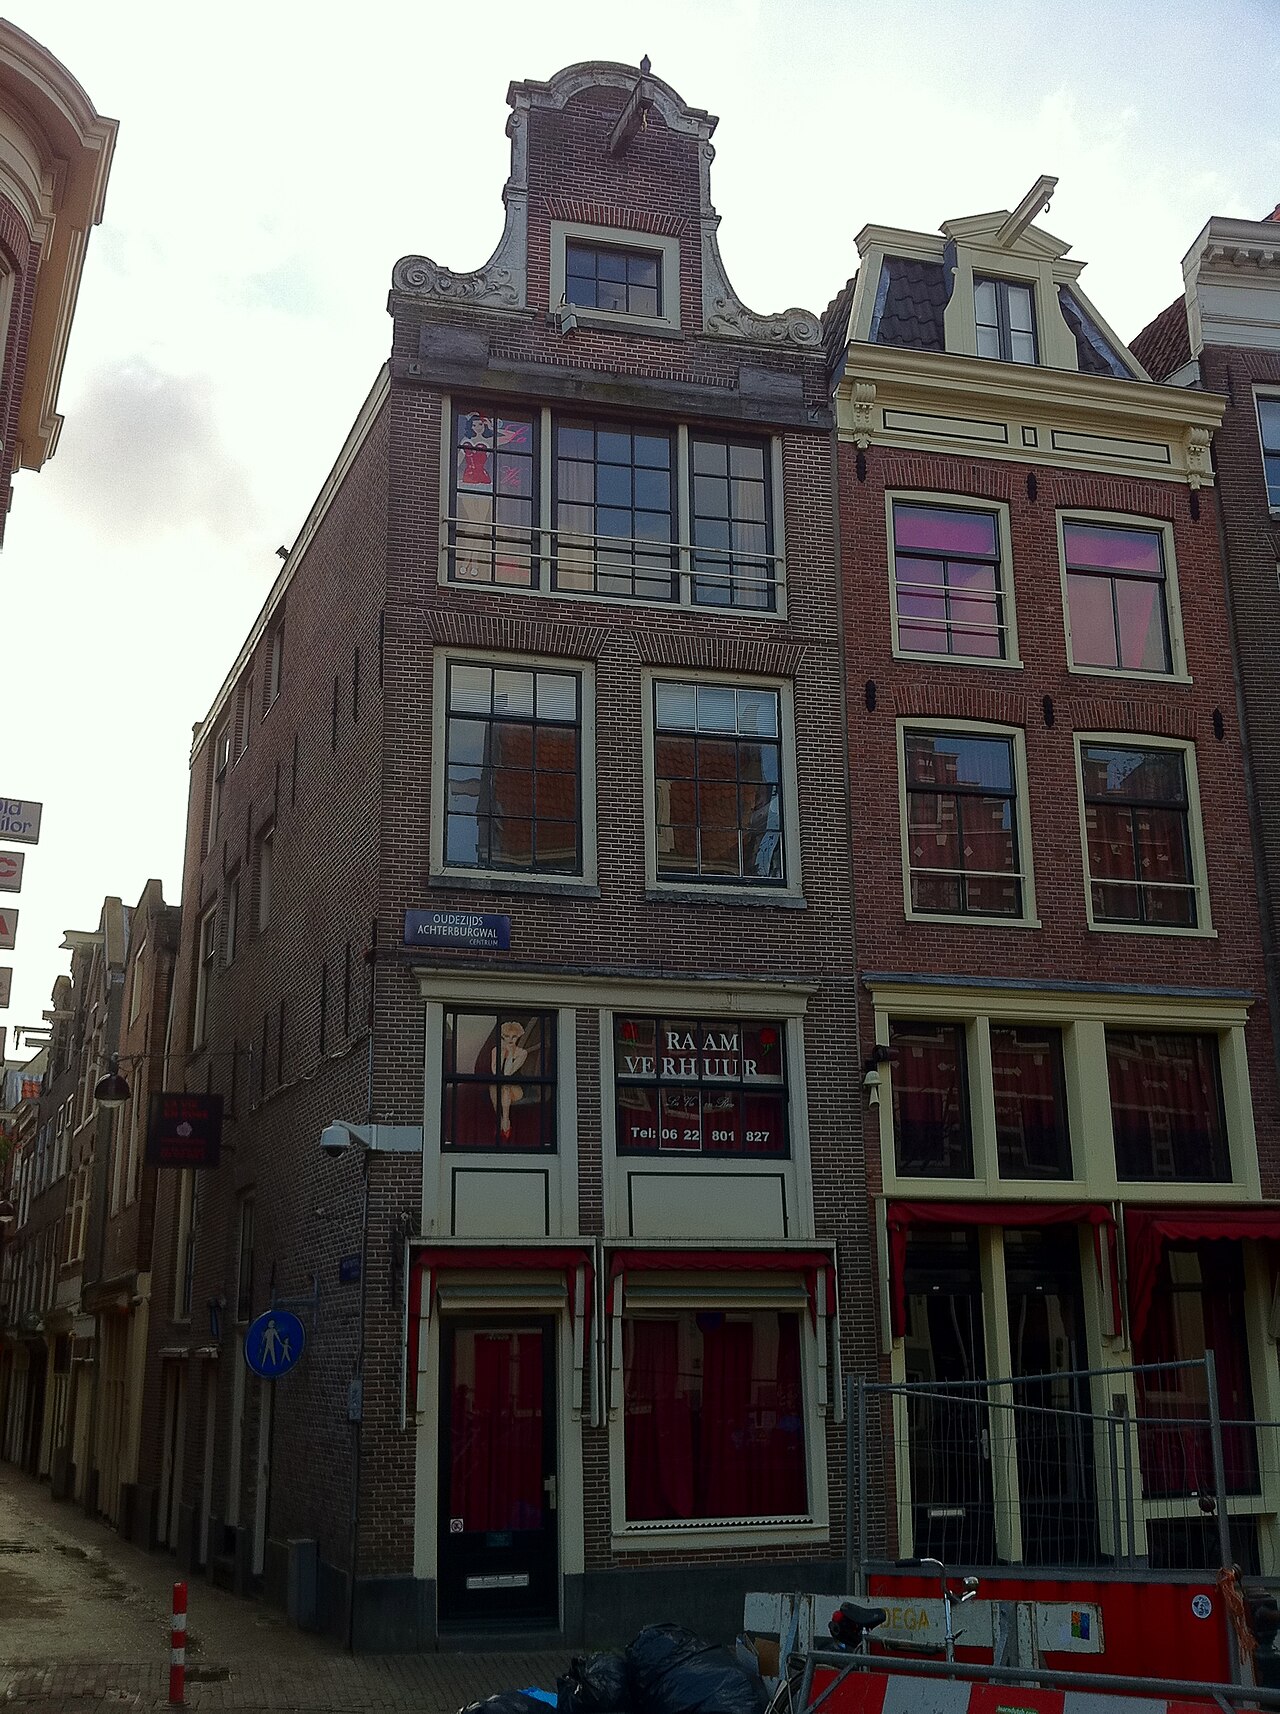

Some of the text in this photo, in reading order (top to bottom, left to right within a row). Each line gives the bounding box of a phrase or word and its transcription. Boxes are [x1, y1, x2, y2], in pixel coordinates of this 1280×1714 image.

[0, 799, 22, 816] ld
[433, 914, 483, 927] OUDEZIJDS
[417, 924, 498, 939] ACHTERBURGWAL
[469, 938, 498, 946] CENTRUM
[624, 1055, 760, 1077] VERHUUR
[631, 1127, 770, 1142] Tel: 06 22 801 827
